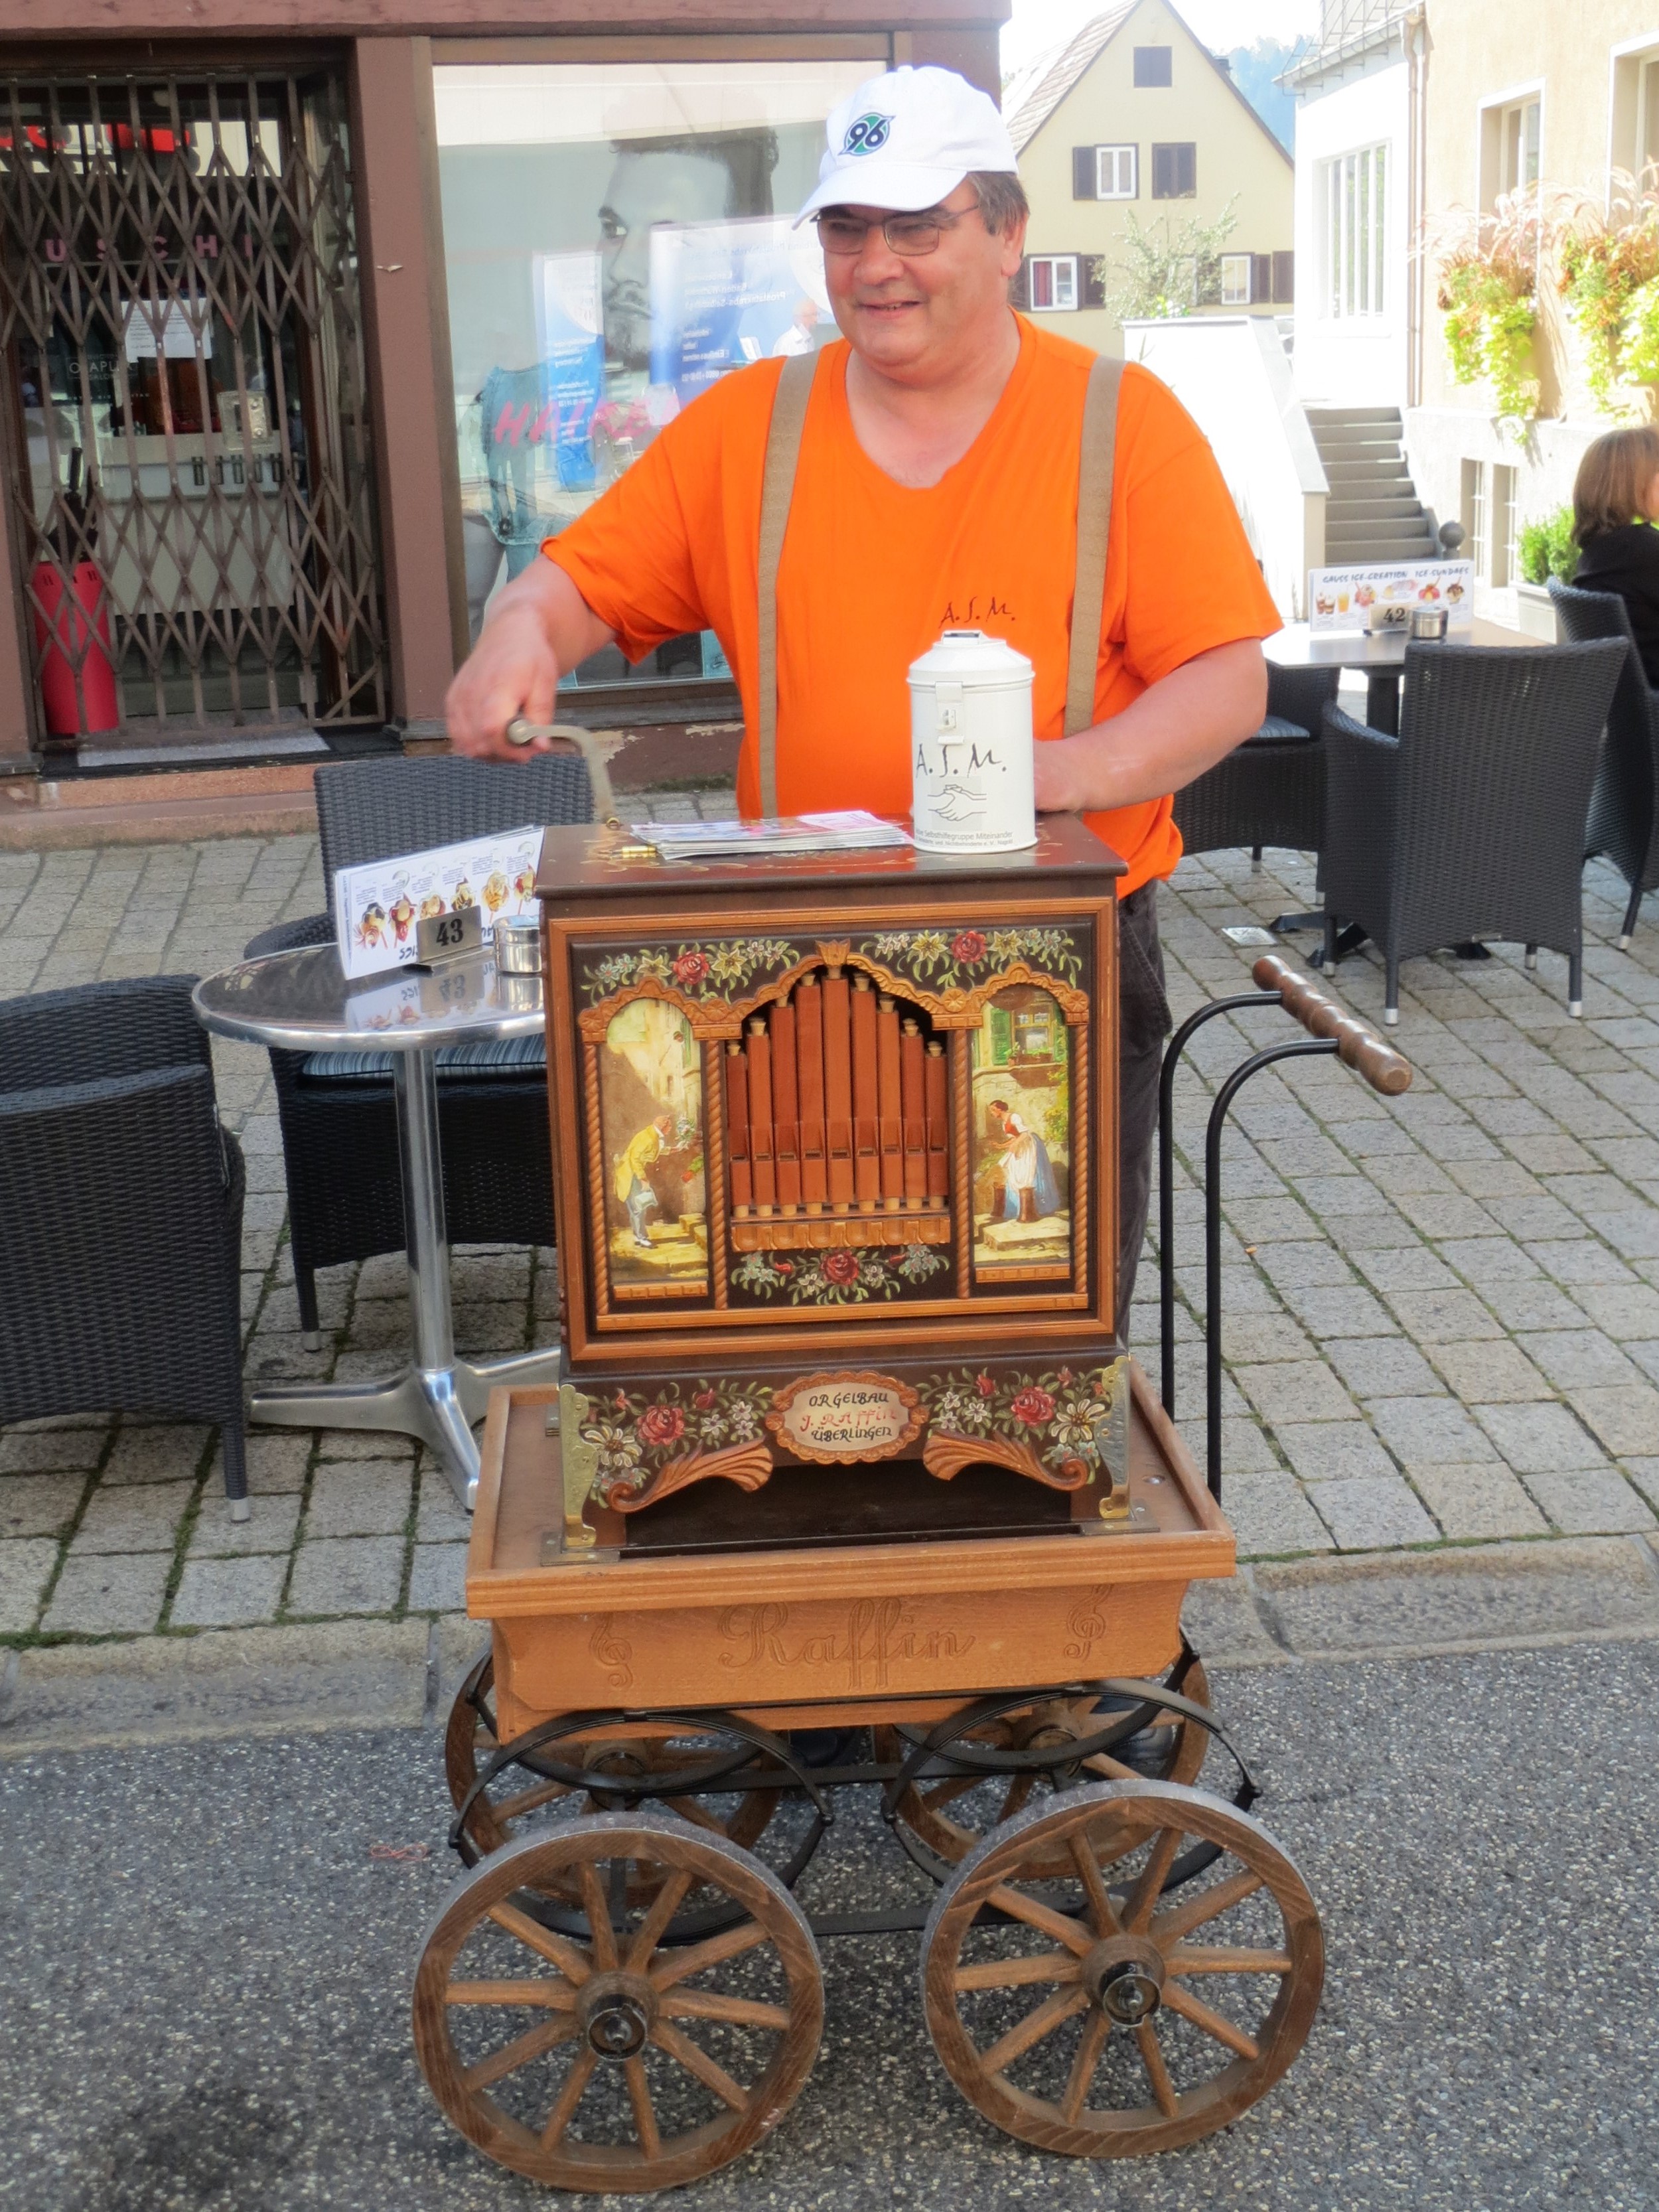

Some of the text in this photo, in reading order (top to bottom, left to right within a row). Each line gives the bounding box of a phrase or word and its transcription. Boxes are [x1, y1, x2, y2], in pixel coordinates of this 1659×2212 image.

[846, 119, 888, 151] 96
[1383, 607, 1406, 623] 42
[976, 830, 1013, 840] Miteinander
[436, 919, 464, 946] 43
[809, 1392, 889, 1408] ORGELBAU
[717, 1596, 976, 1690] Raffin
